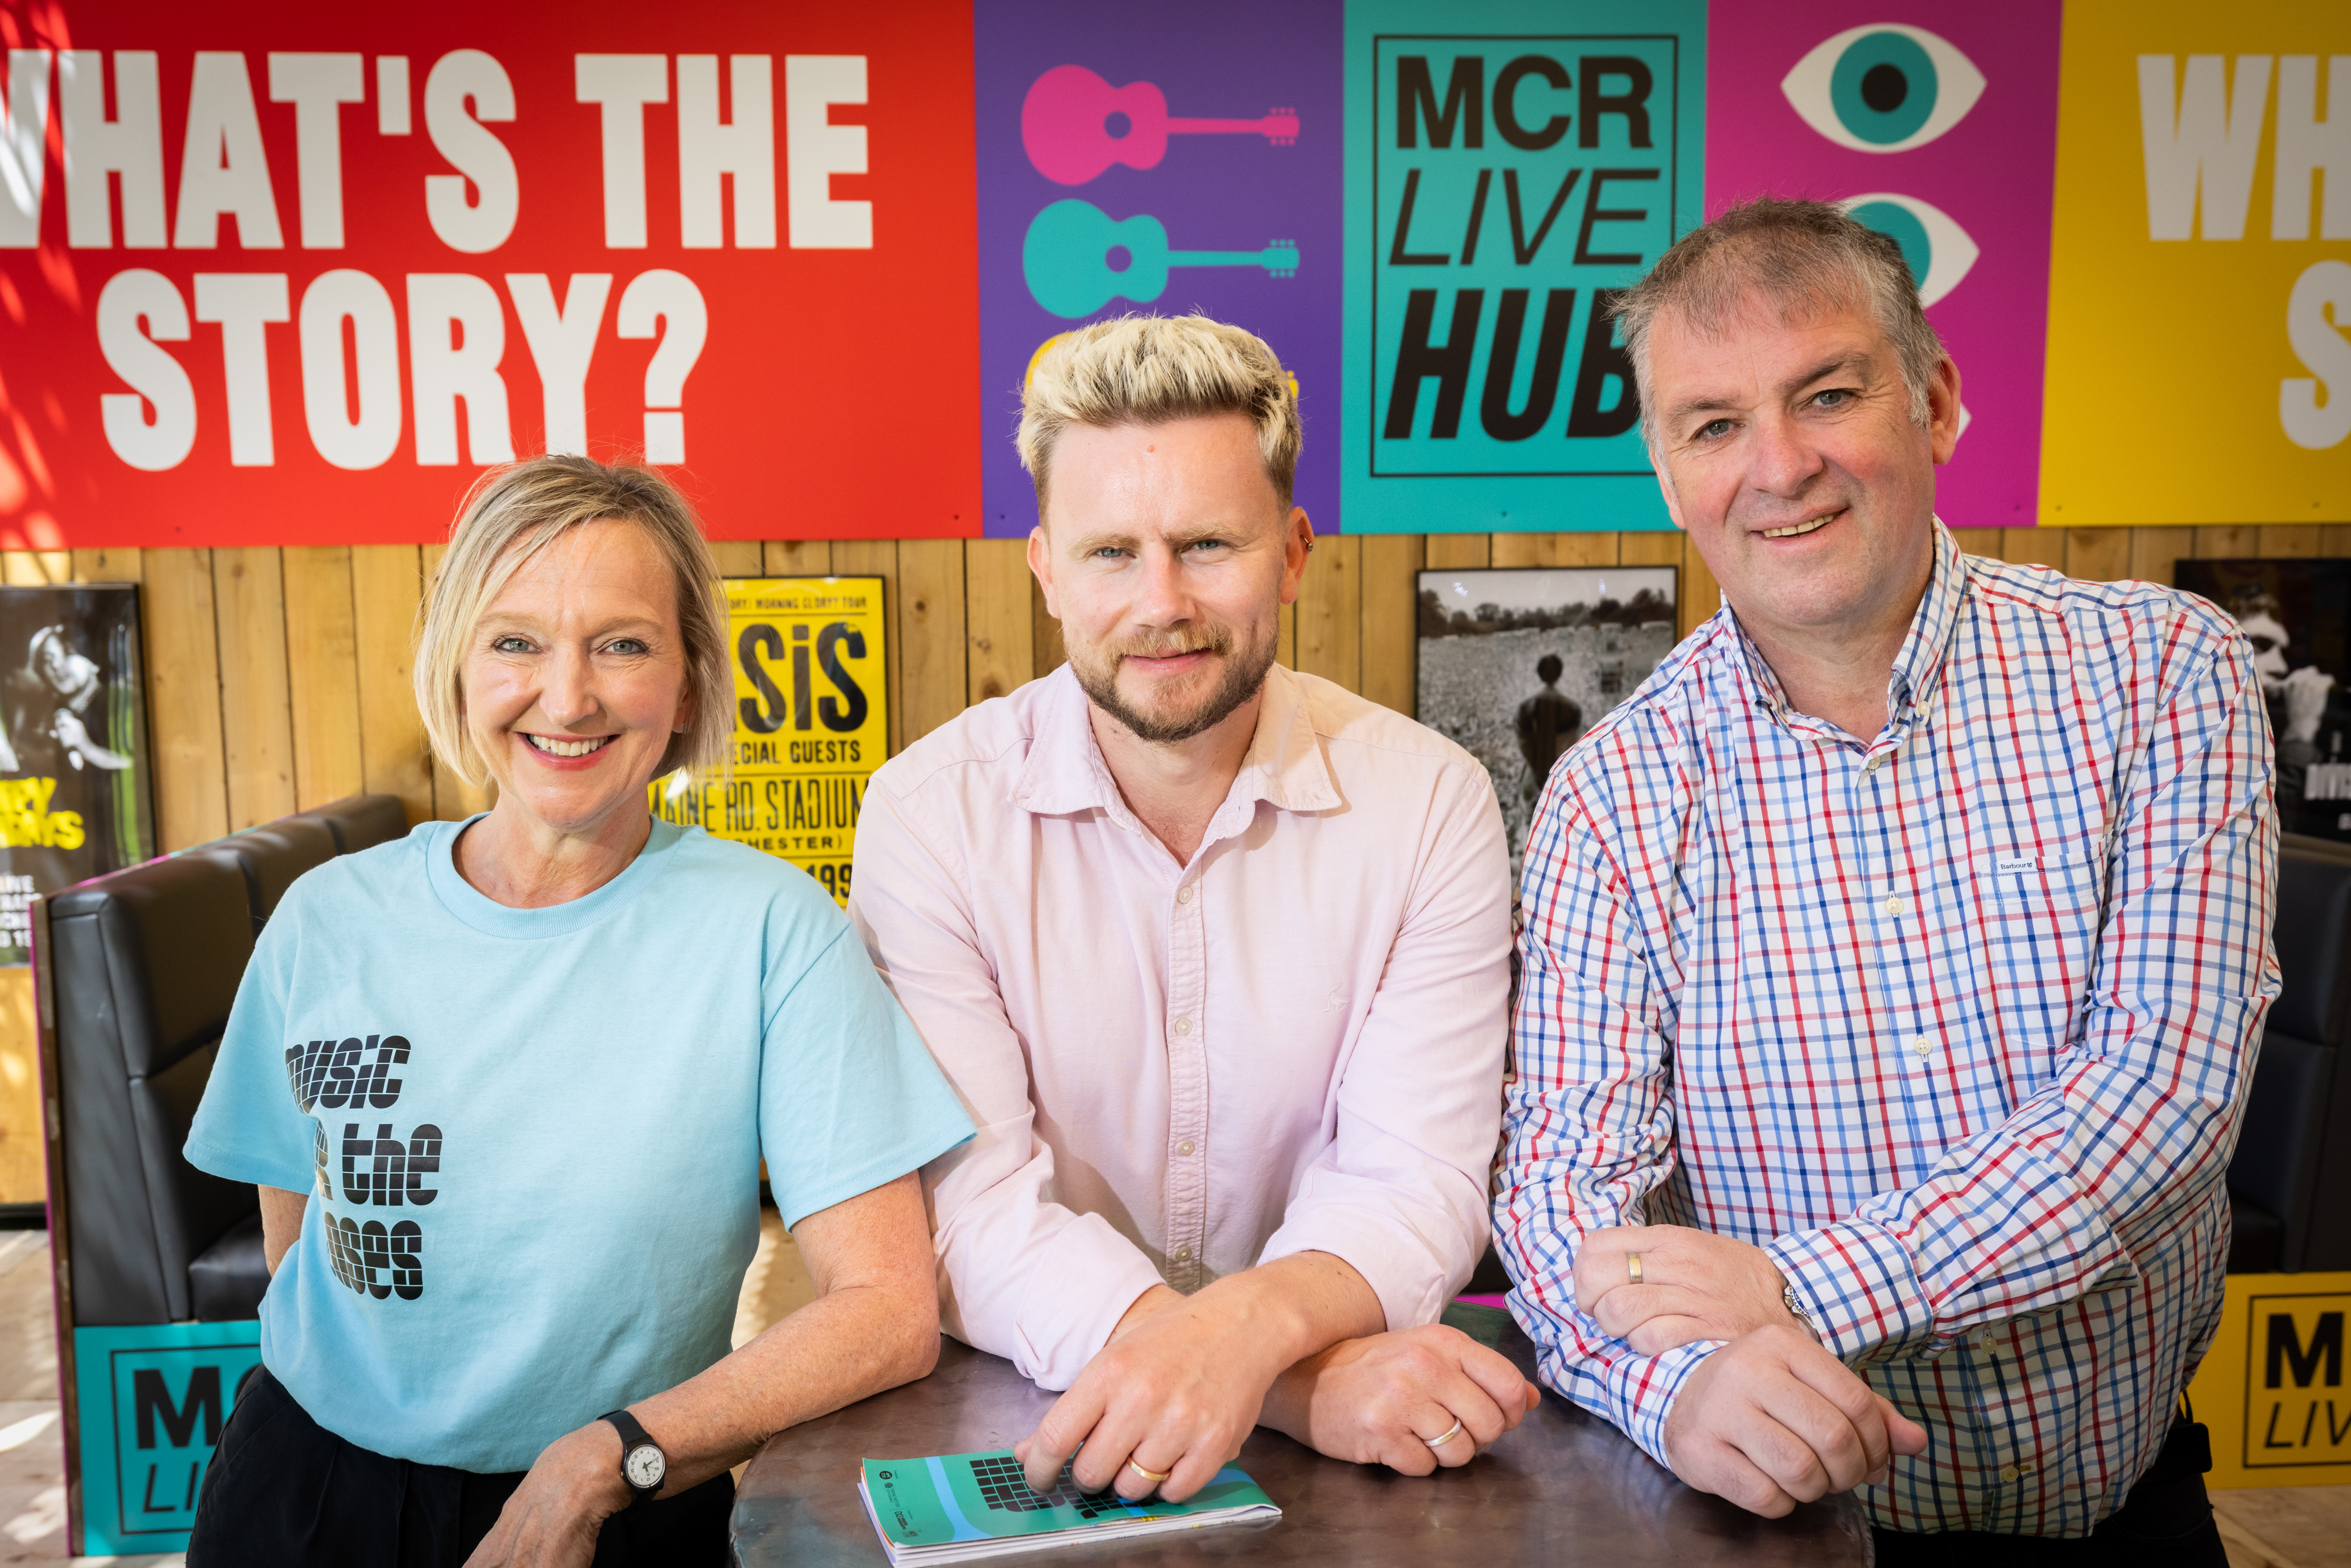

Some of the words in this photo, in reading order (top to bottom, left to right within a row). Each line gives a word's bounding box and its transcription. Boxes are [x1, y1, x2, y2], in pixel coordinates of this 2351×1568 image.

[575, 53, 873, 249] THE
[1396, 53, 1654, 152] MCR
[1388, 168, 1661, 266] LIVE
[97, 268, 708, 472] STORY?
[1383, 288, 1643, 442] HUB
[843, 596, 866, 608] TOUR
[735, 620, 868, 734] SiS
[790, 739, 861, 763] GUESTS
[726, 780, 760, 832] RD.
[342, 1123, 443, 1206] the
[133, 1363, 263, 1450] M
